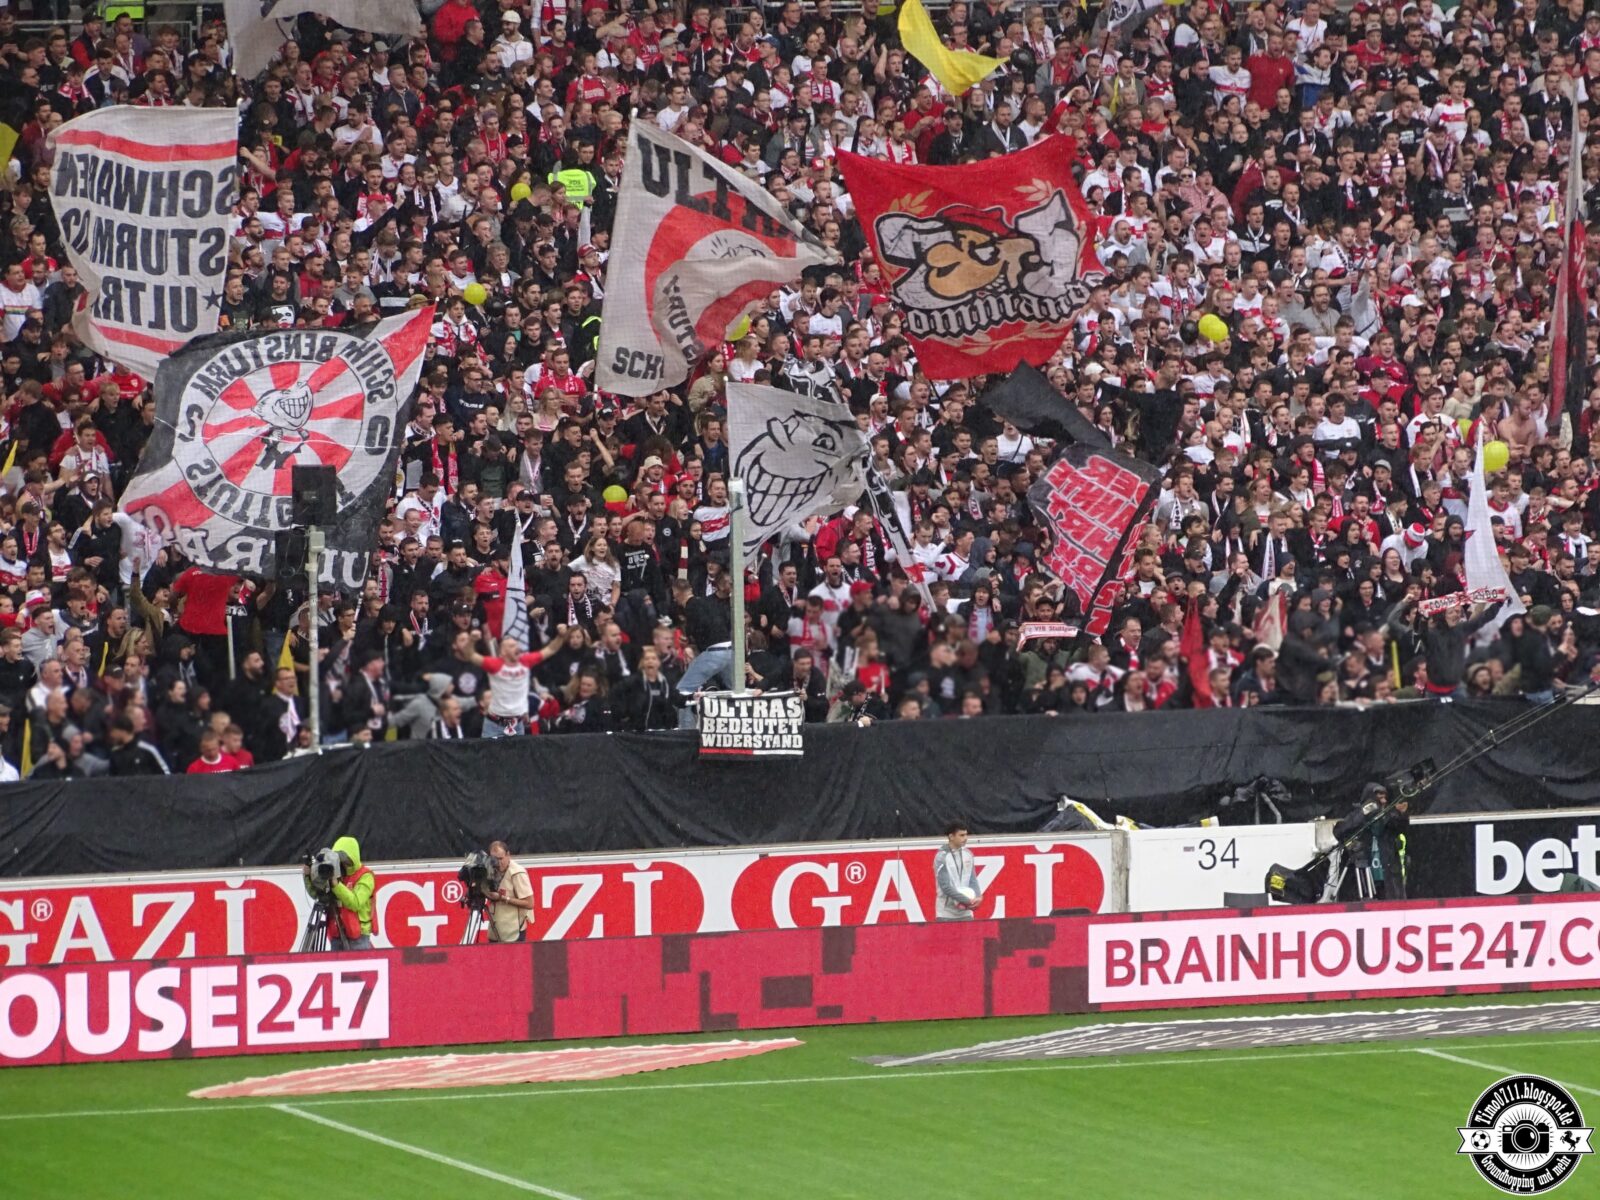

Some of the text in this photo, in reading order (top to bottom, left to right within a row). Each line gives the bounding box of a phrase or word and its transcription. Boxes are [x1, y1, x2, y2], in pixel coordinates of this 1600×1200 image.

[703, 697, 803, 718] ULTRAS
[702, 717, 803, 735] BEDEUTET
[701, 733, 804, 749] WIDERSTAND
[1198, 838, 1240, 870] 34
[1475, 824, 1600, 895] bet
[1105, 916, 1600, 988] BRAINHOUSE247.C
